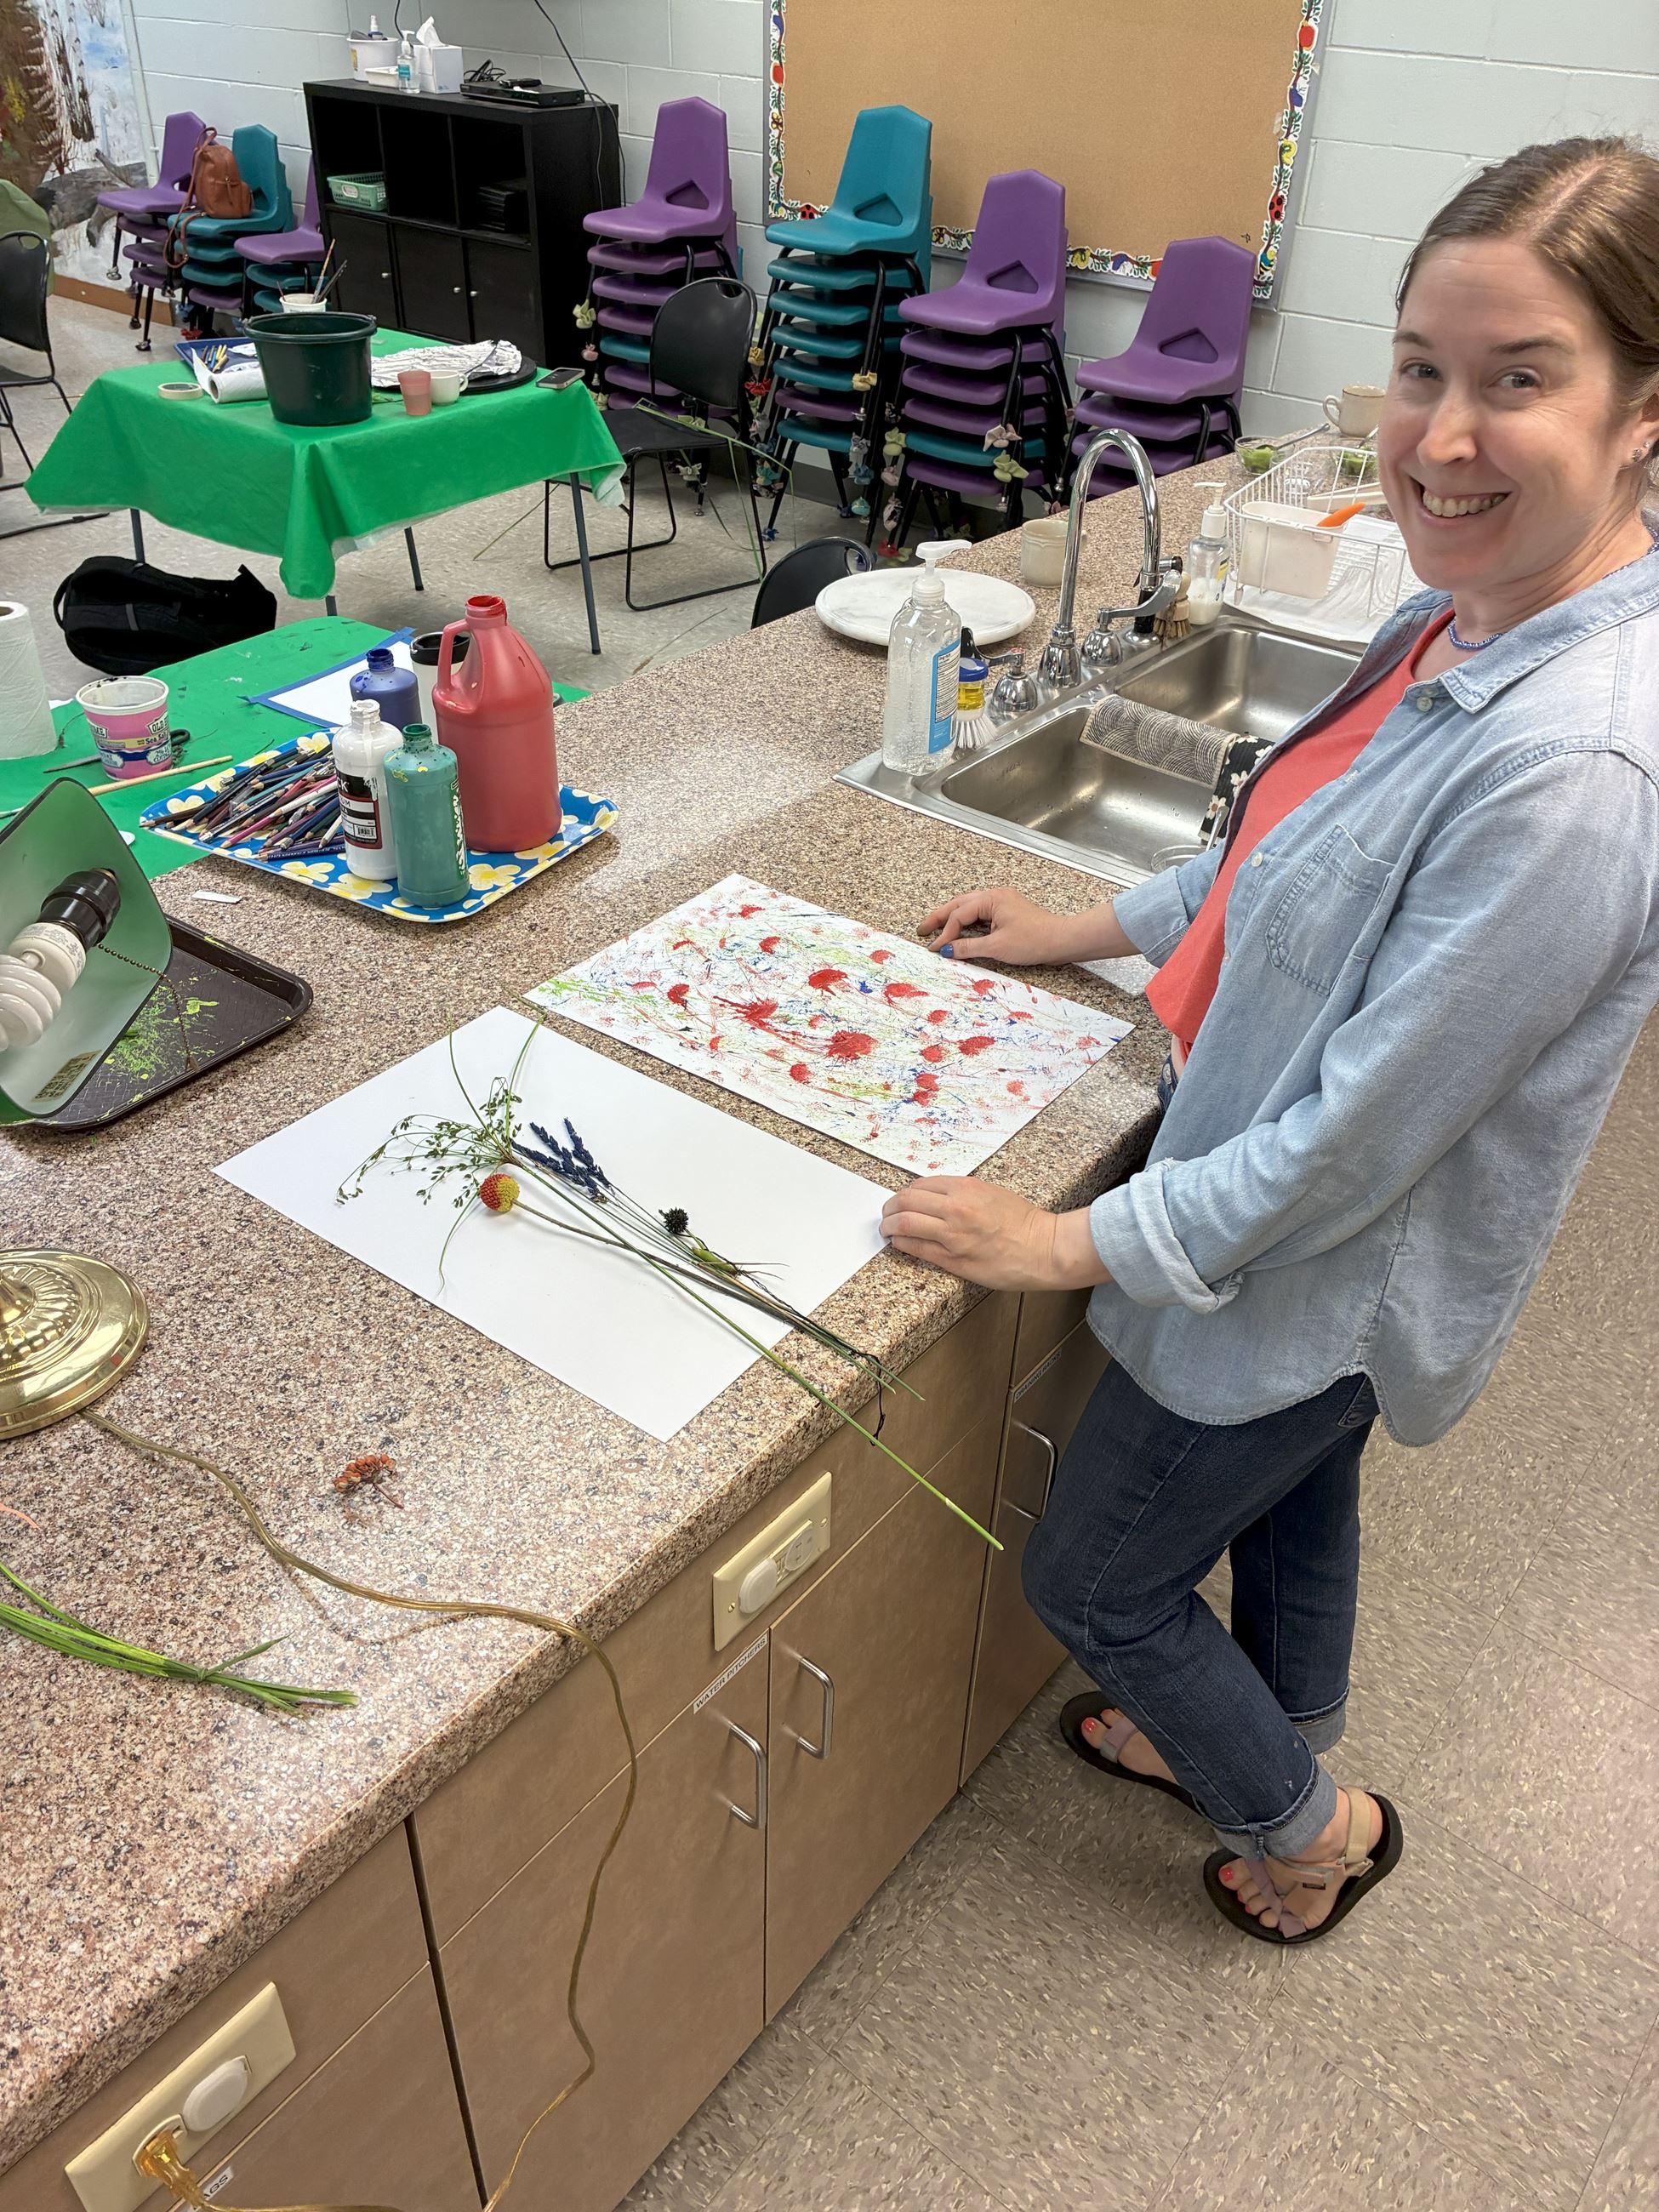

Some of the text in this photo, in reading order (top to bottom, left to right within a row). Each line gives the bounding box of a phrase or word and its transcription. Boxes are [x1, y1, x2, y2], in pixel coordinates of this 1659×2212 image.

[152, 720, 164, 733] OLD
[696, 1638, 766, 1708] WATER PITCHERS
